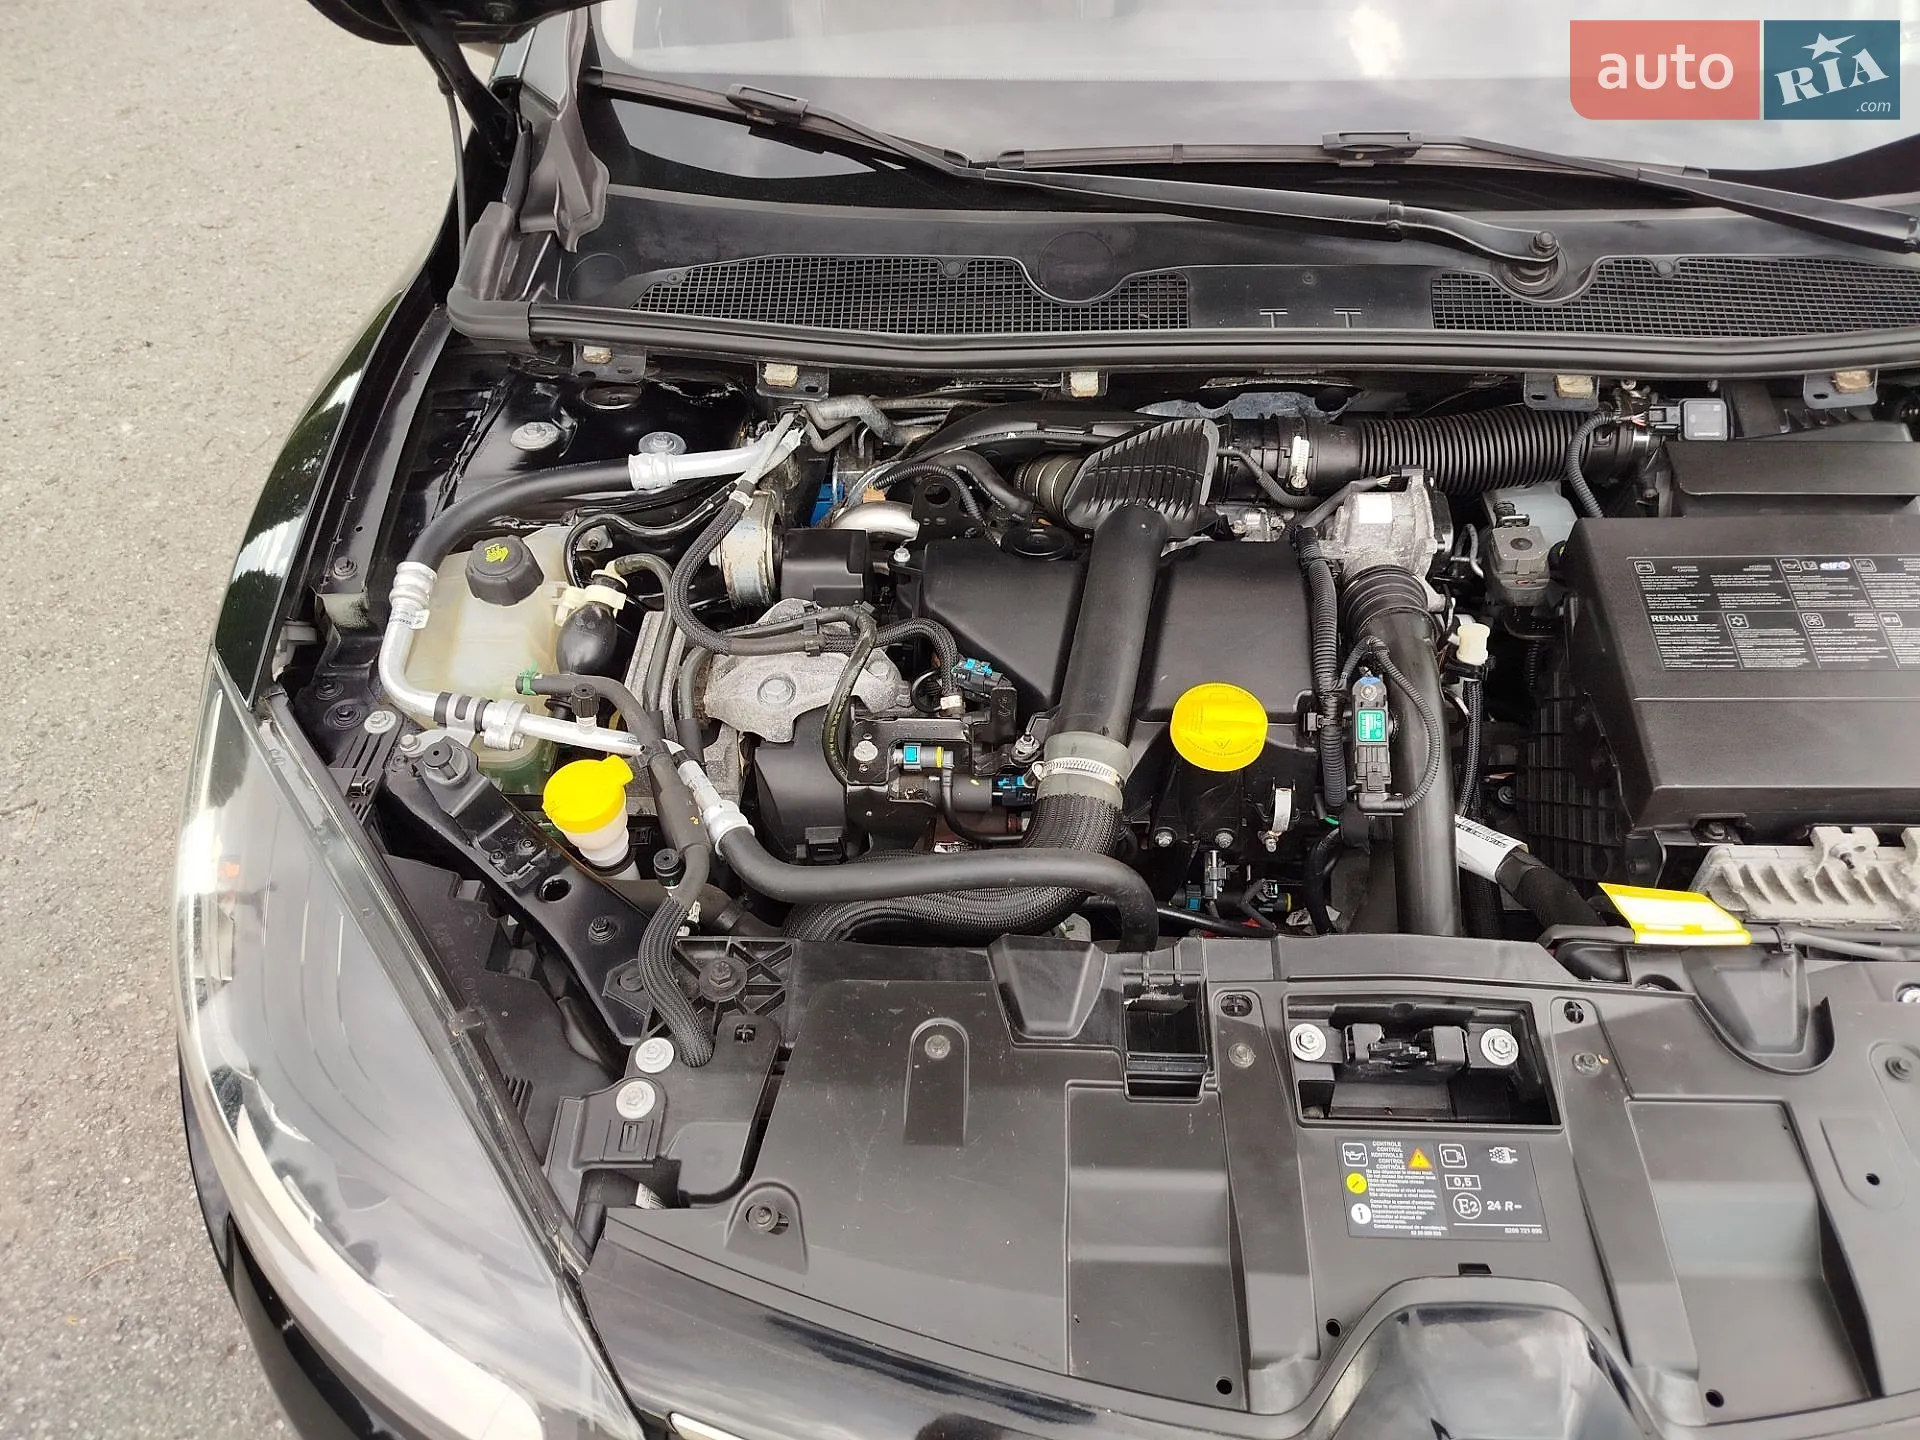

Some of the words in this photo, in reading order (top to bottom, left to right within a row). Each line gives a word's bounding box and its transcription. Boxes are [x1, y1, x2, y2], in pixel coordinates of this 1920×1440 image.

[1453, 1177, 1472, 1188] 0,5
[1457, 1198, 1479, 1214] E2
[1486, 1200, 1502, 1211] 24
